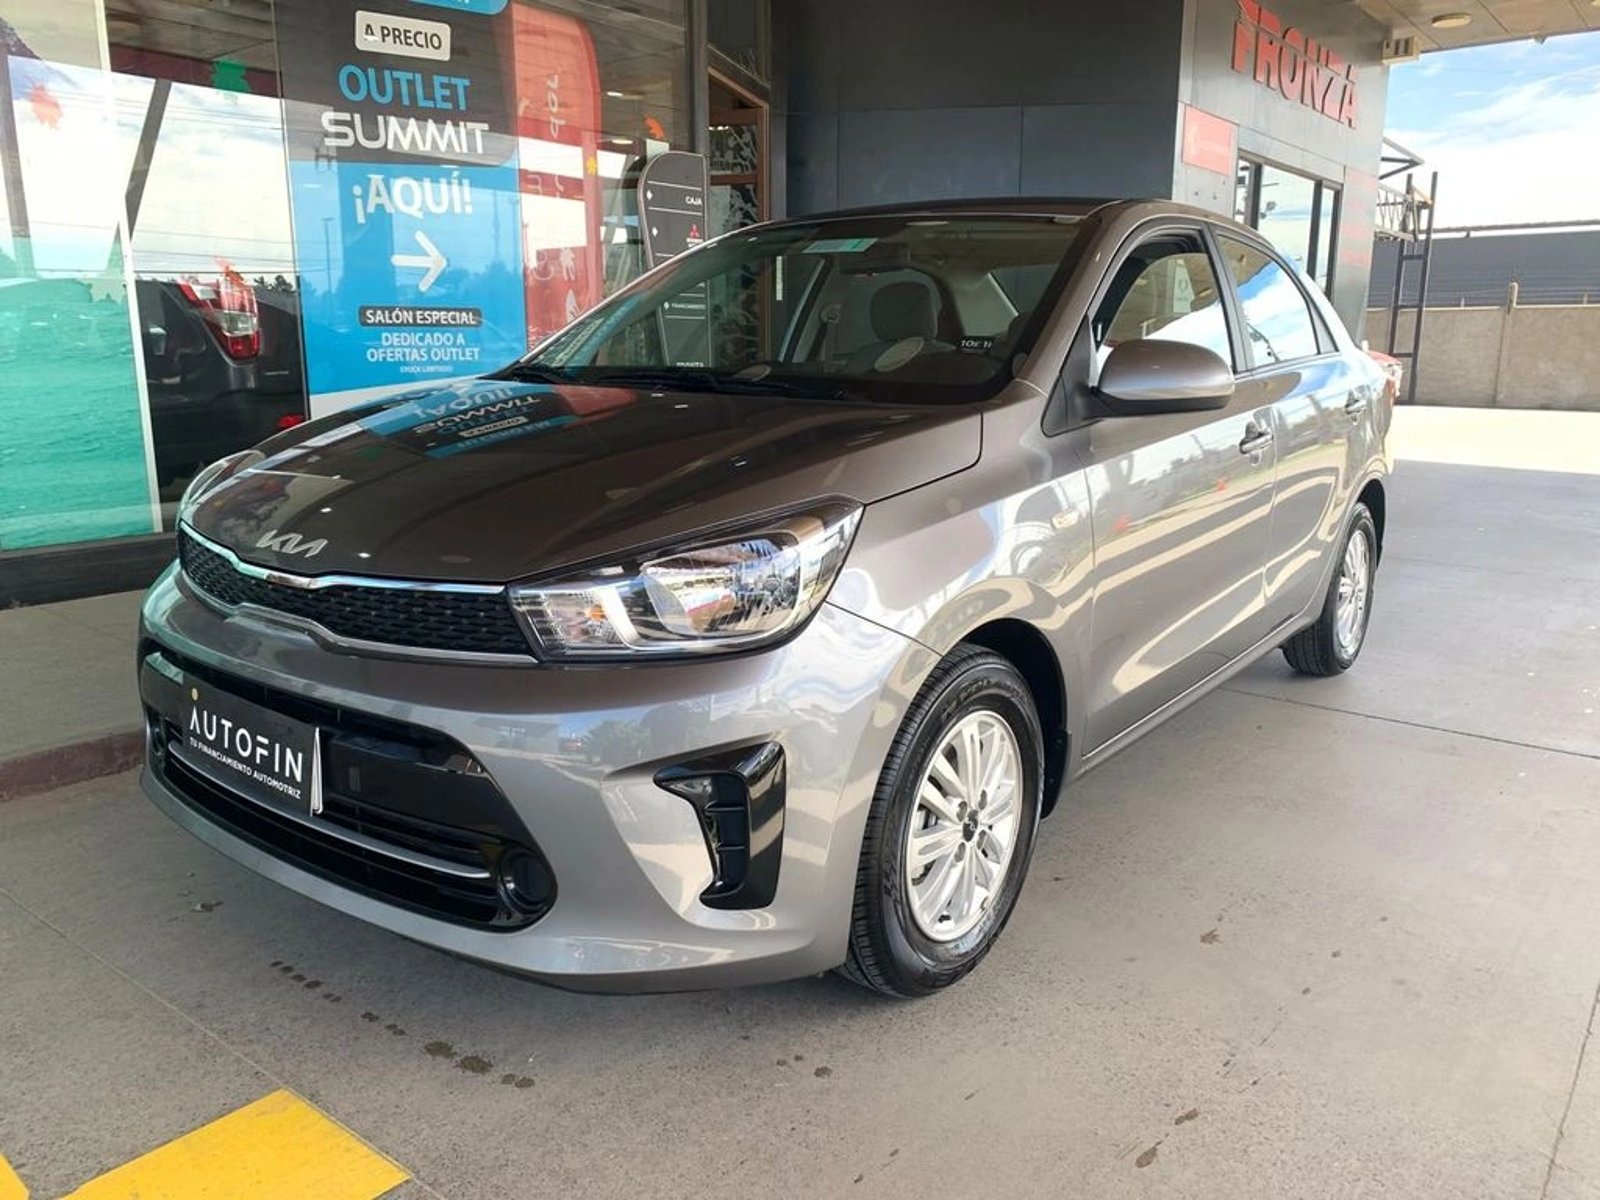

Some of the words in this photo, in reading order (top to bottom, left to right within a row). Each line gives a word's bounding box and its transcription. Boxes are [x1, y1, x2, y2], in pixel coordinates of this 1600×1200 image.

[364, 23, 377, 40] A
[380, 25, 443, 50] PRECIO
[338, 64, 471, 111] OUTLET
[321, 111, 490, 154] SUMMIT
[353, 171, 473, 224] ¡AQUÍ!
[365, 308, 413, 324] SALÓN
[416, 310, 477, 325] ESPECIAL
[366, 348, 428, 362] OFERTAS
[431, 348, 480, 360] OUTLET
[381, 332, 454, 346] DEDICADO
[456, 333, 466, 346] A
[255, 529, 328, 558] KIA
[189, 703, 303, 782] AUTOFIN
[189, 737, 198, 748] TU
[198, 741, 252, 776] FINANCIAMIENTO
[253, 770, 302, 799] AUTOMOTRIZ
